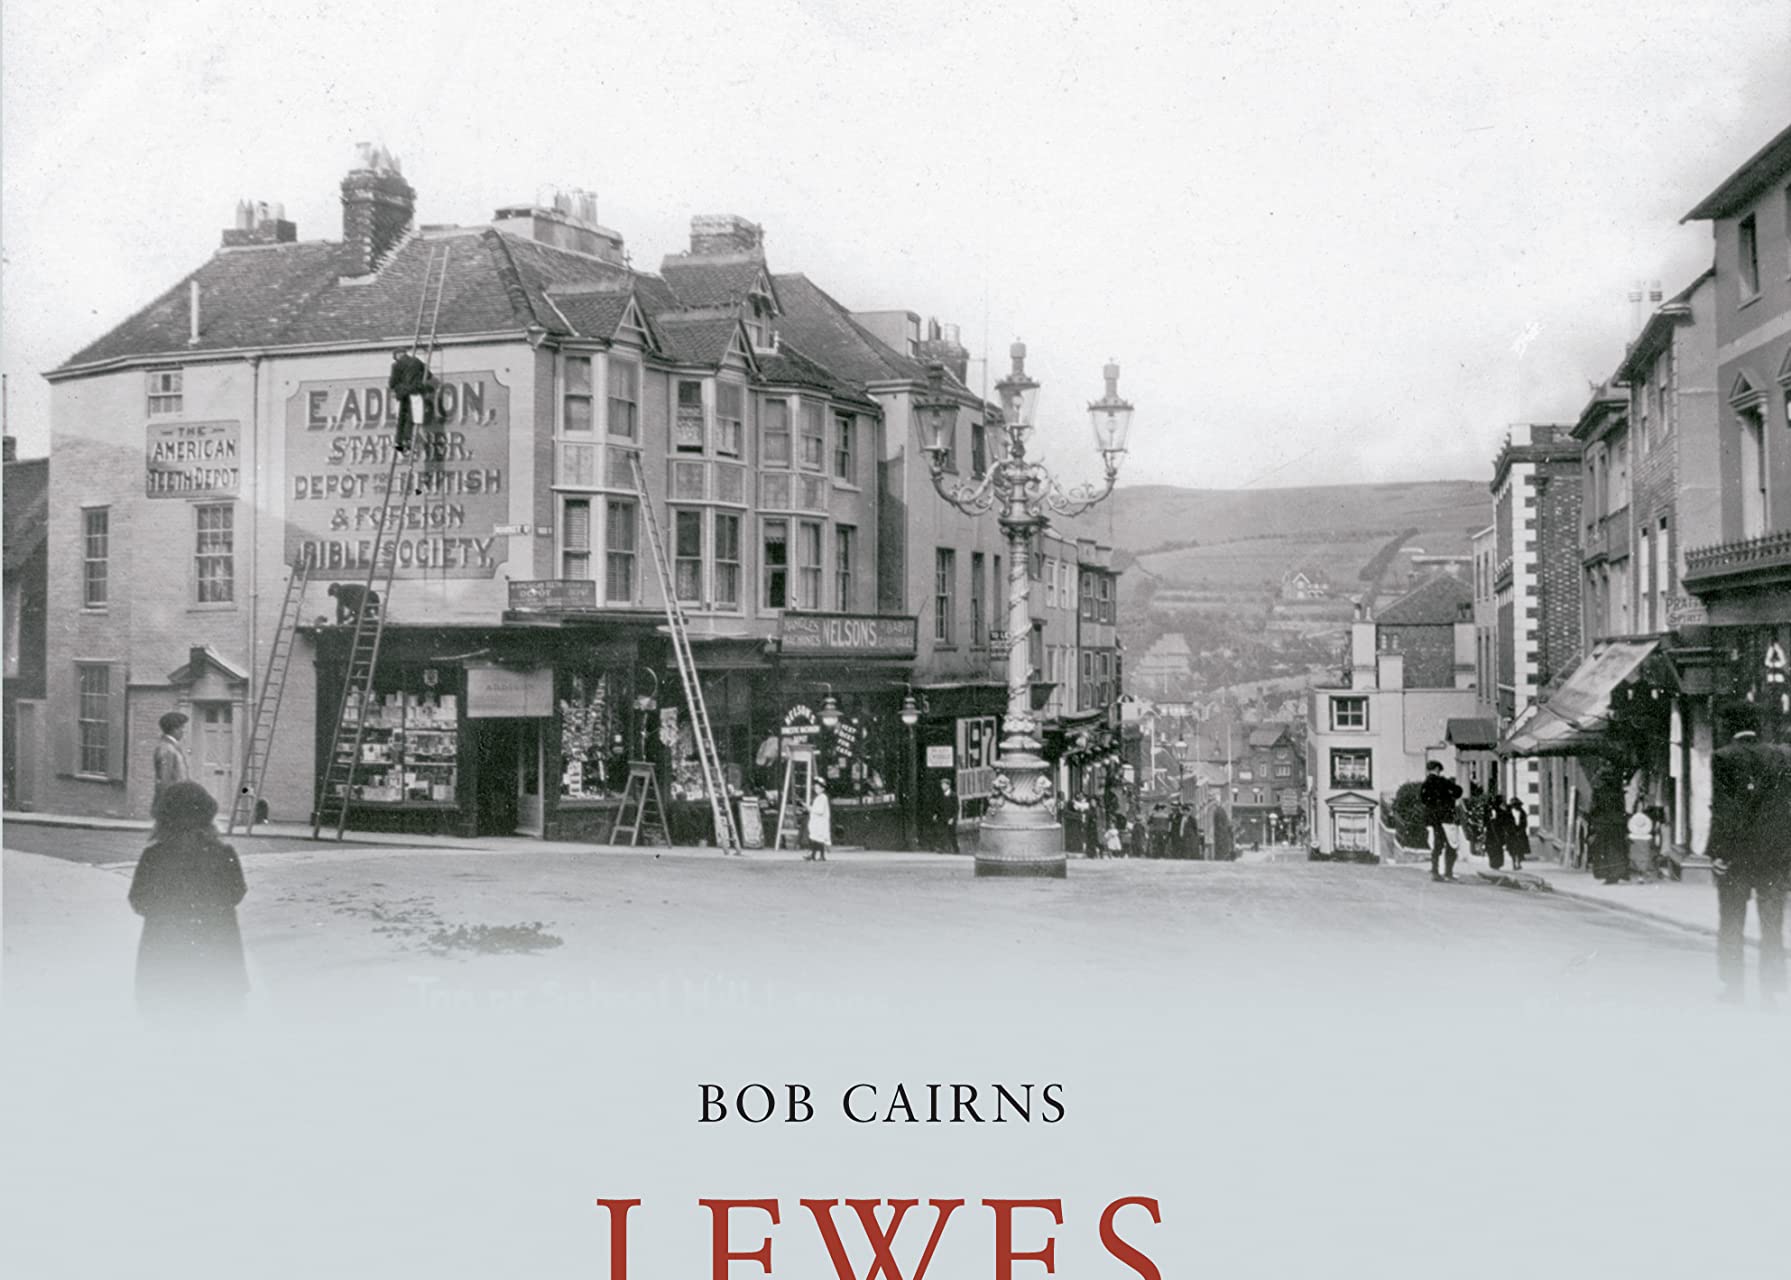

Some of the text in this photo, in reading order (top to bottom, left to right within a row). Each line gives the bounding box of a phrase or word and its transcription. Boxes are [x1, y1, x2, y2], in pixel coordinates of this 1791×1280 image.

[178, 426, 206, 436] THE
[151, 440, 236, 462] AMERICAN
[192, 466, 239, 490] DEPOT
[294, 473, 369, 499] DEPOT
[331, 507, 348, 531] &
[823, 620, 877, 647] NELSONS
